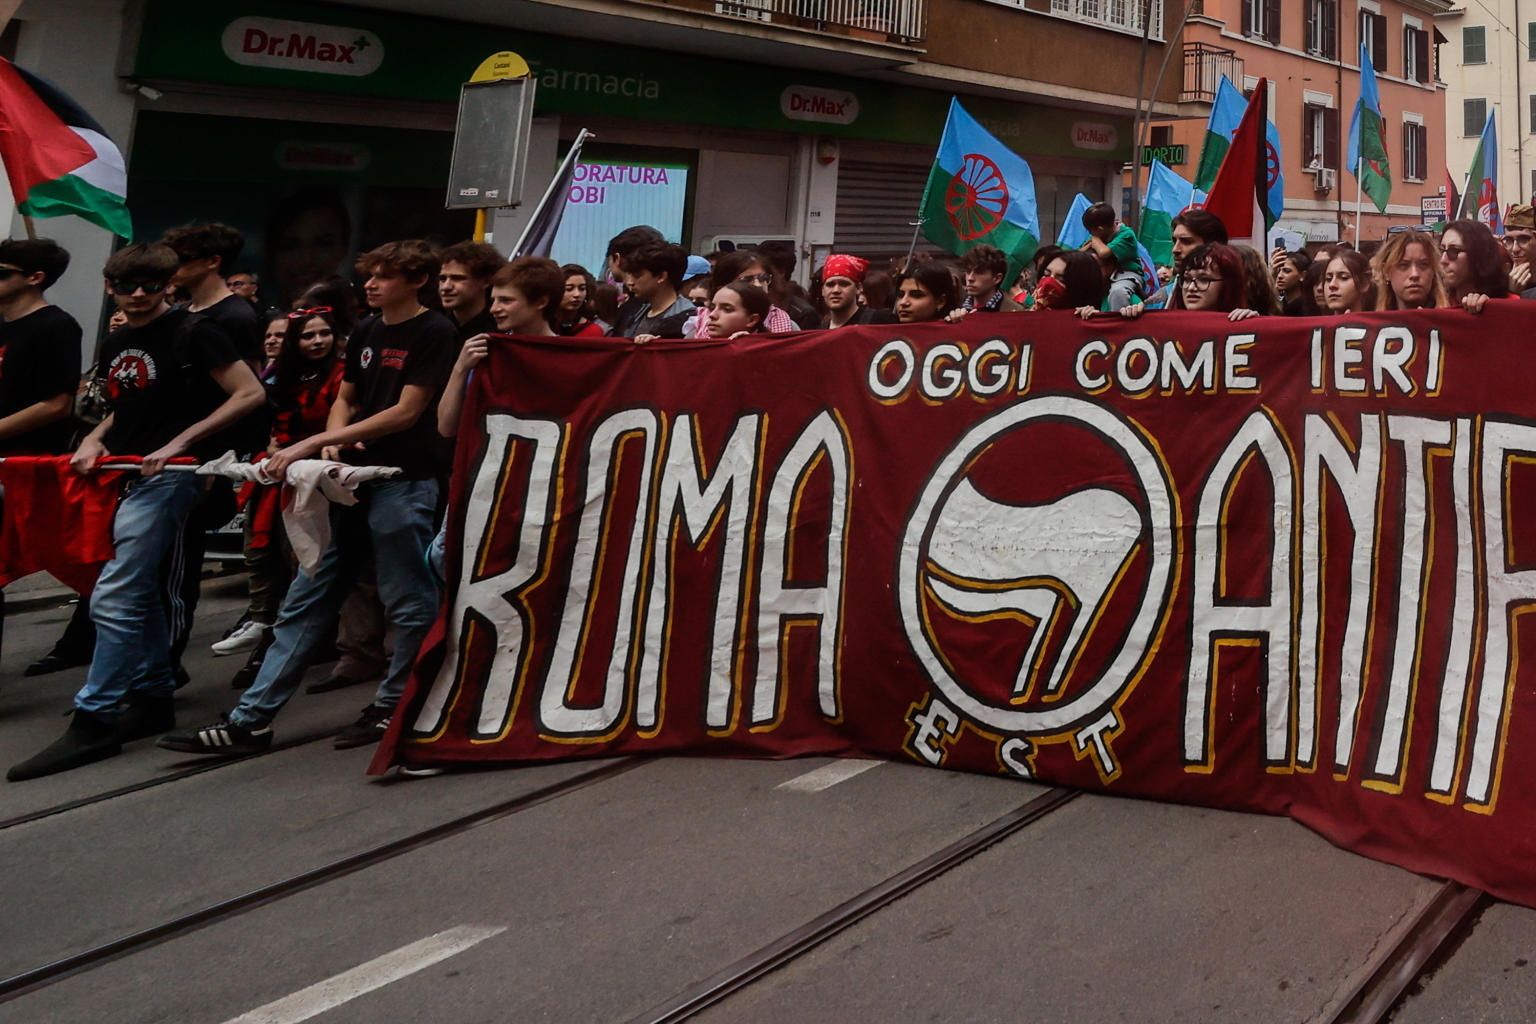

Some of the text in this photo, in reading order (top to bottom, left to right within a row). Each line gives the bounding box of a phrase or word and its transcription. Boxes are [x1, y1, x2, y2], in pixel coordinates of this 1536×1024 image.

[242, 28, 356, 64] Dr.Max
[789, 93, 845, 116] Dr.Max
[1142, 146, 1183, 164] DARIO
[573, 163, 669, 185] ORATURA
[568, 185, 605, 204] OBI
[868, 326, 1443, 401] OGGI COME IERI
[412, 406, 850, 738] ROMA
